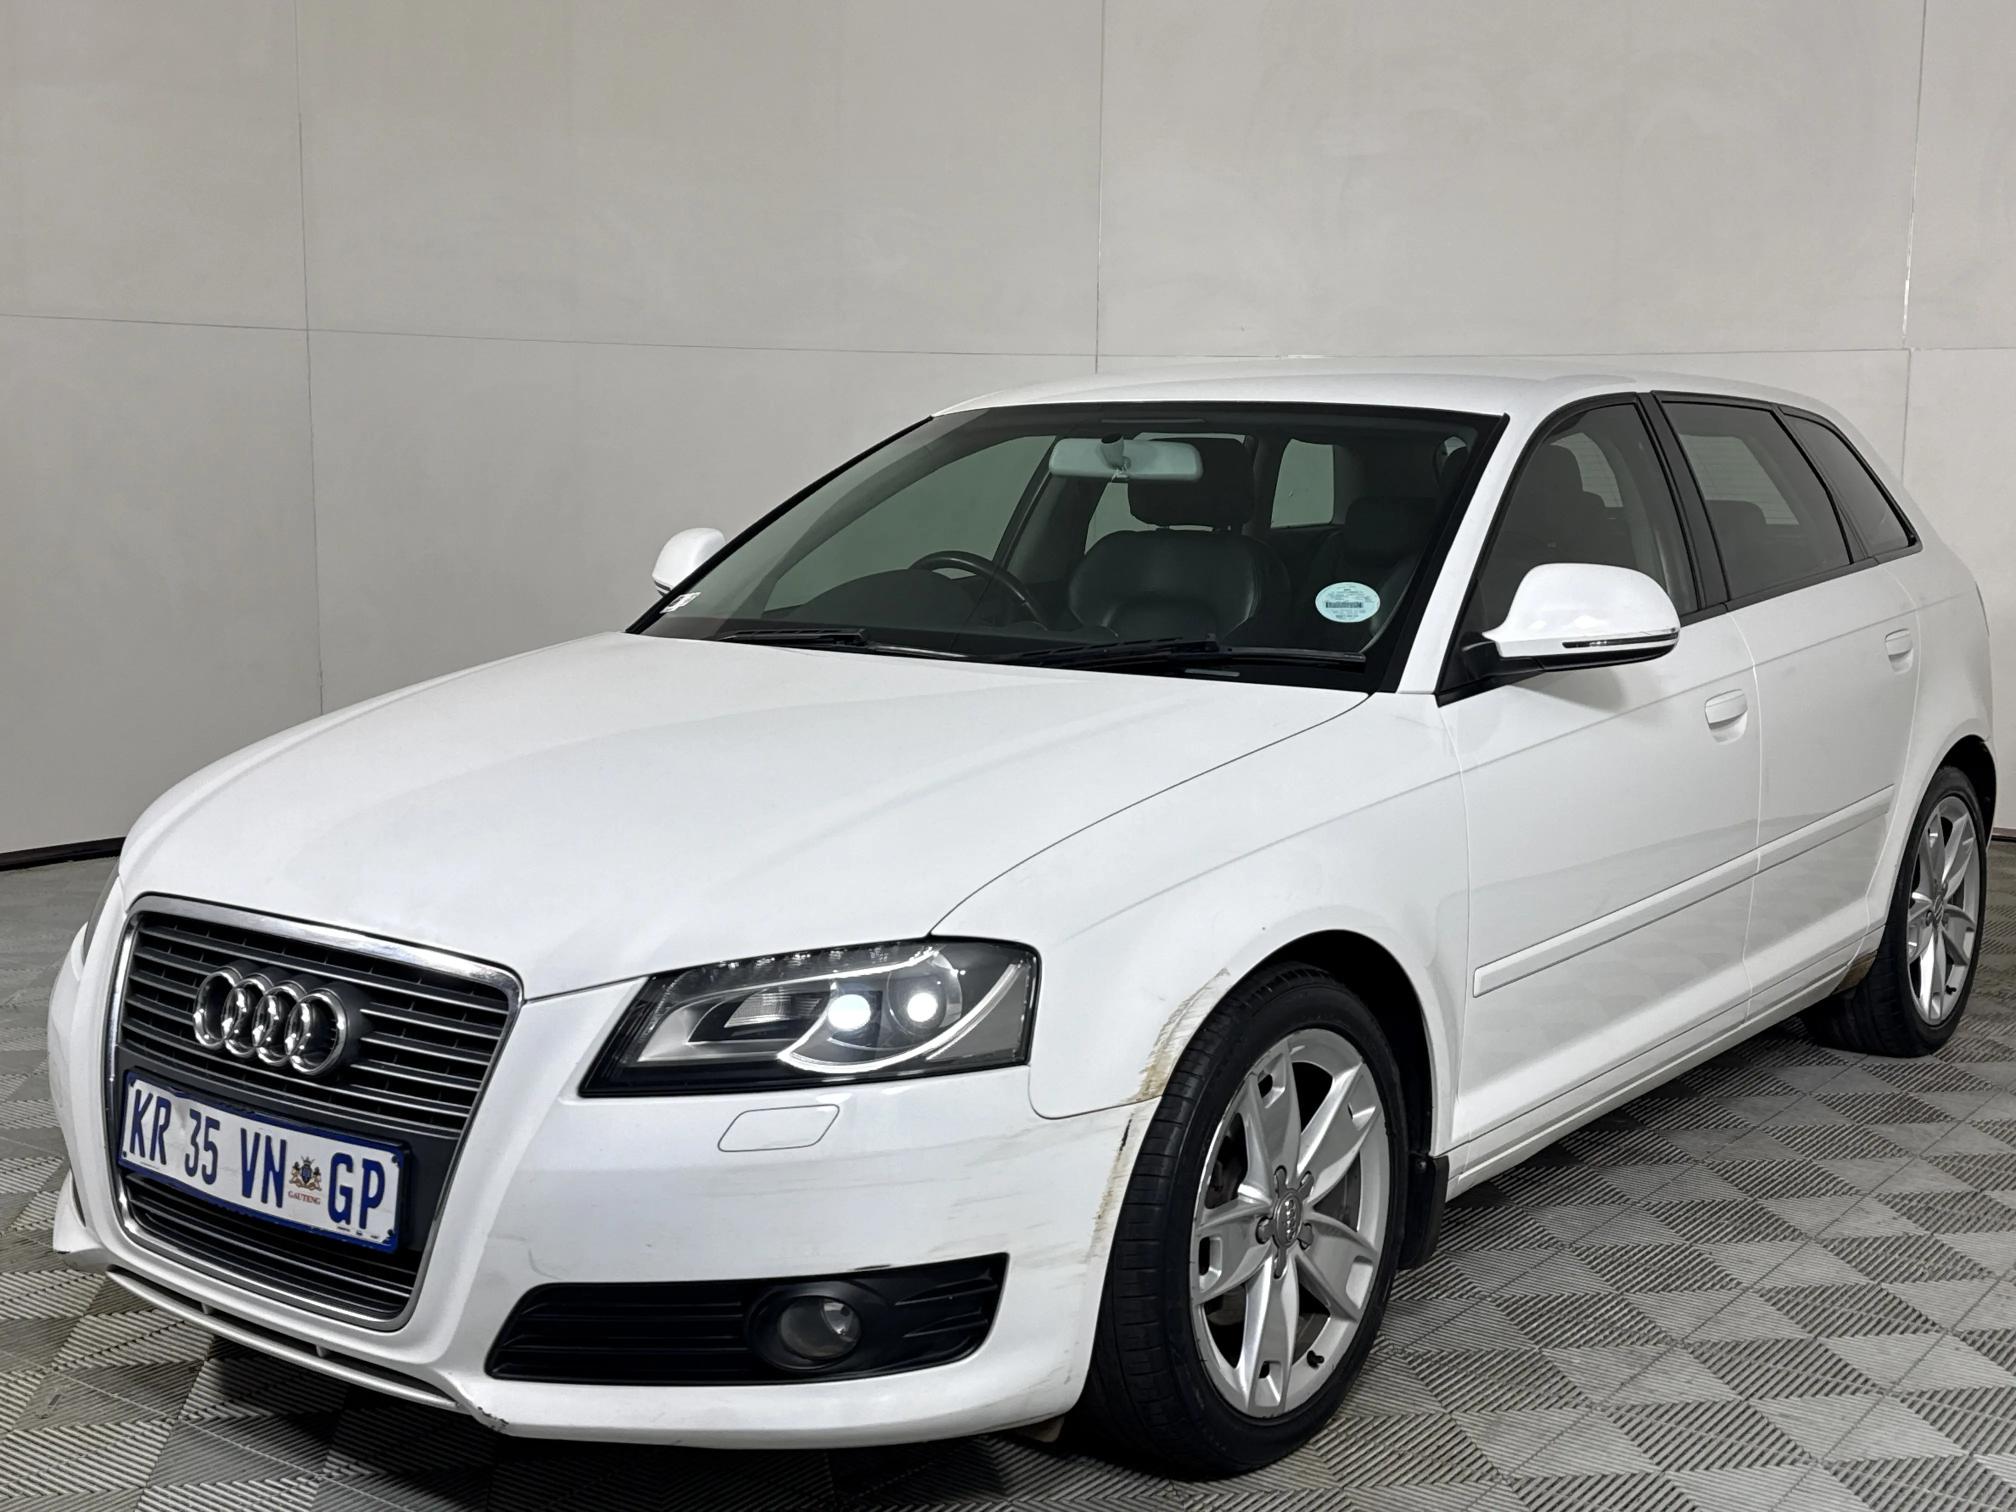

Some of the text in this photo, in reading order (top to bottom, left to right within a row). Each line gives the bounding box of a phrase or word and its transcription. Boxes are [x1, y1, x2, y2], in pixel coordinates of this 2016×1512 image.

[129, 1088, 385, 1230] KR 35 VN GP
[287, 1190, 321, 1205] GAUTENG
